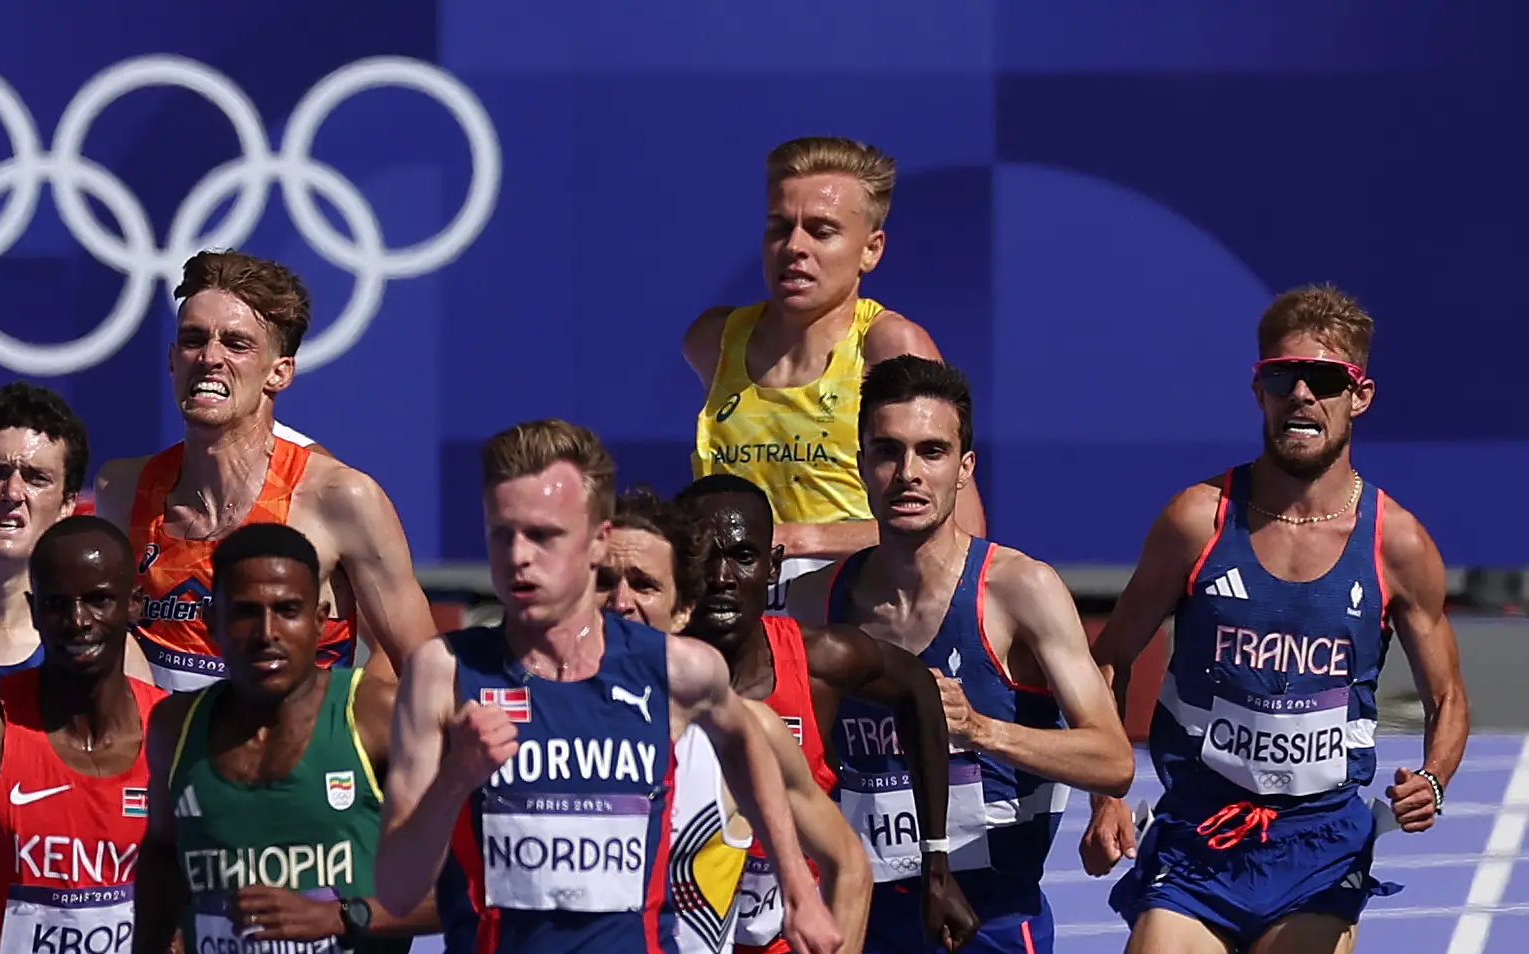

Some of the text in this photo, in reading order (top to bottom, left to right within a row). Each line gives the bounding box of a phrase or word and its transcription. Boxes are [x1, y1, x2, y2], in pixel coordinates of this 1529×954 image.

[714, 443, 828, 464] AUSTRALIA
[158, 651, 194, 668] PARIS
[1214, 624, 1351, 677] FRANCE
[1246, 695, 1318, 710] PARIS 2024
[842, 716, 905, 757] FRA
[1209, 718, 1344, 765] GRESSIER
[490, 737, 657, 788] NORWAY
[861, 777, 898, 788] PARIS
[526, 798, 613, 812] PARIS 2024
[184, 840, 353, 892] ETHIOPIA
[486, 835, 643, 872] NORDAS
[52, 893, 91, 903] PARIS
